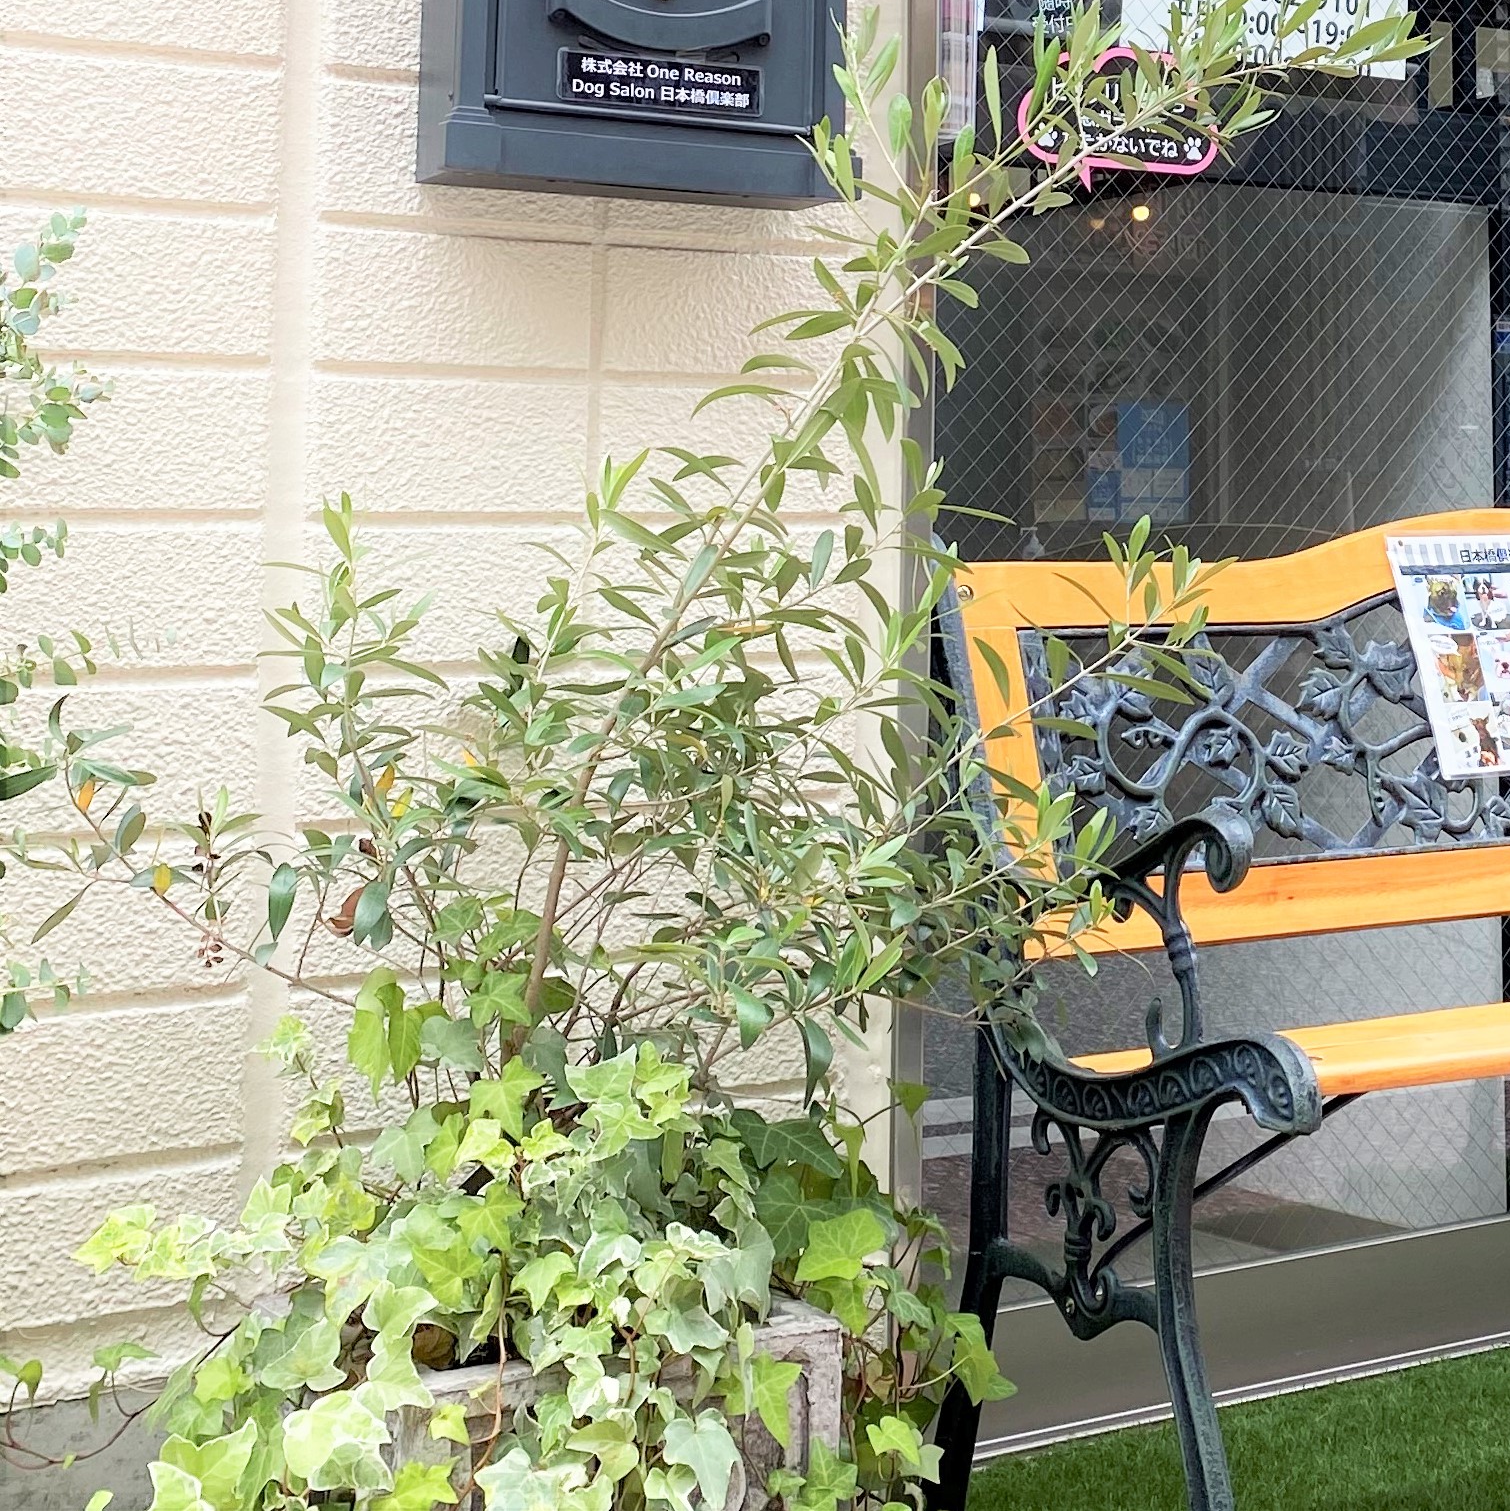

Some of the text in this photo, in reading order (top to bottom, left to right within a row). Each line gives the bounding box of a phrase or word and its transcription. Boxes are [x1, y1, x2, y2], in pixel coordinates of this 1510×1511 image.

[581, 56, 742, 87] 株式会社 One Reason
[572, 78, 605, 98] Dog
[609, 82, 655, 99] Salon
